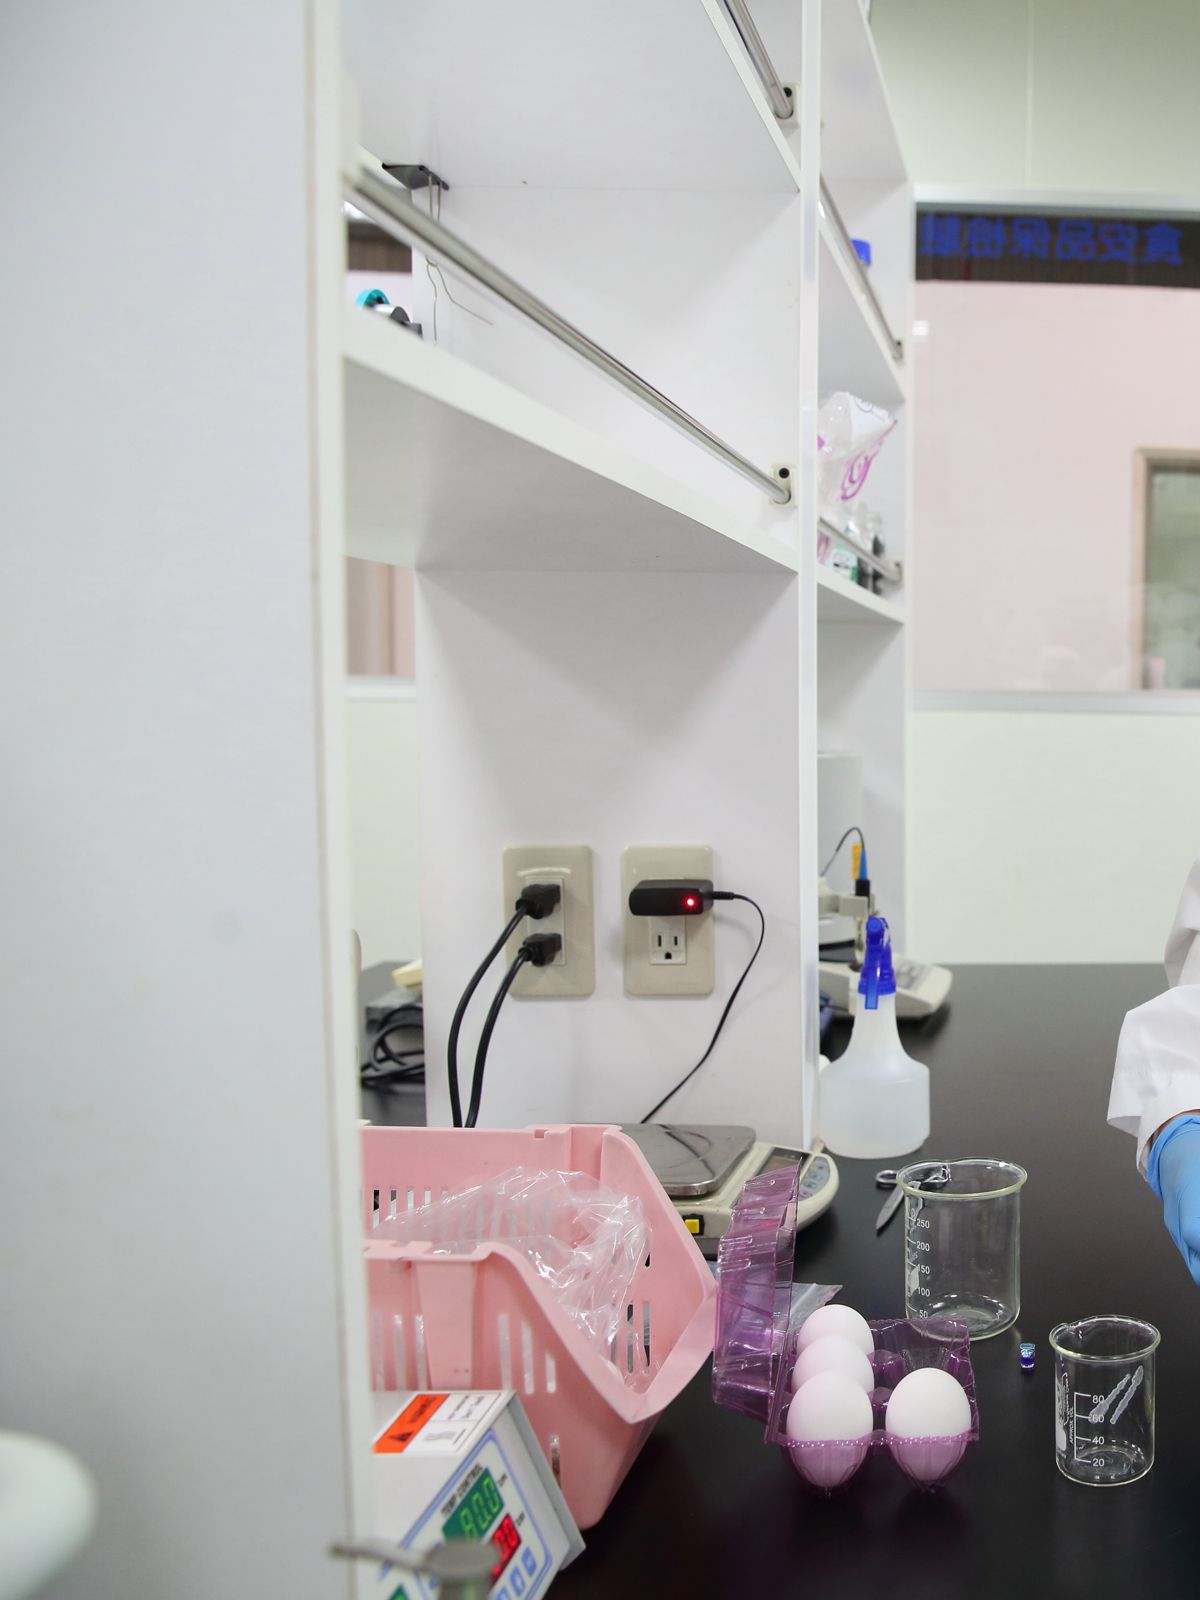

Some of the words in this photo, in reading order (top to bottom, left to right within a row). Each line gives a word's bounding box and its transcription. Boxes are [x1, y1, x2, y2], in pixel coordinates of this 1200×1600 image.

[916, 1218, 930, 1229] 250
[916, 1240, 930, 1251] 200
[917, 1264, 930, 1275] 150
[918, 1287, 930, 1297] 100
[919, 1309, 928, 1319] 50
[1092, 1394, 1105, 1404] 80
[1092, 1414, 1105, 1423] 60
[1091, 1436, 1105, 1445] 40
[1092, 1458, 1105, 1467] 20
